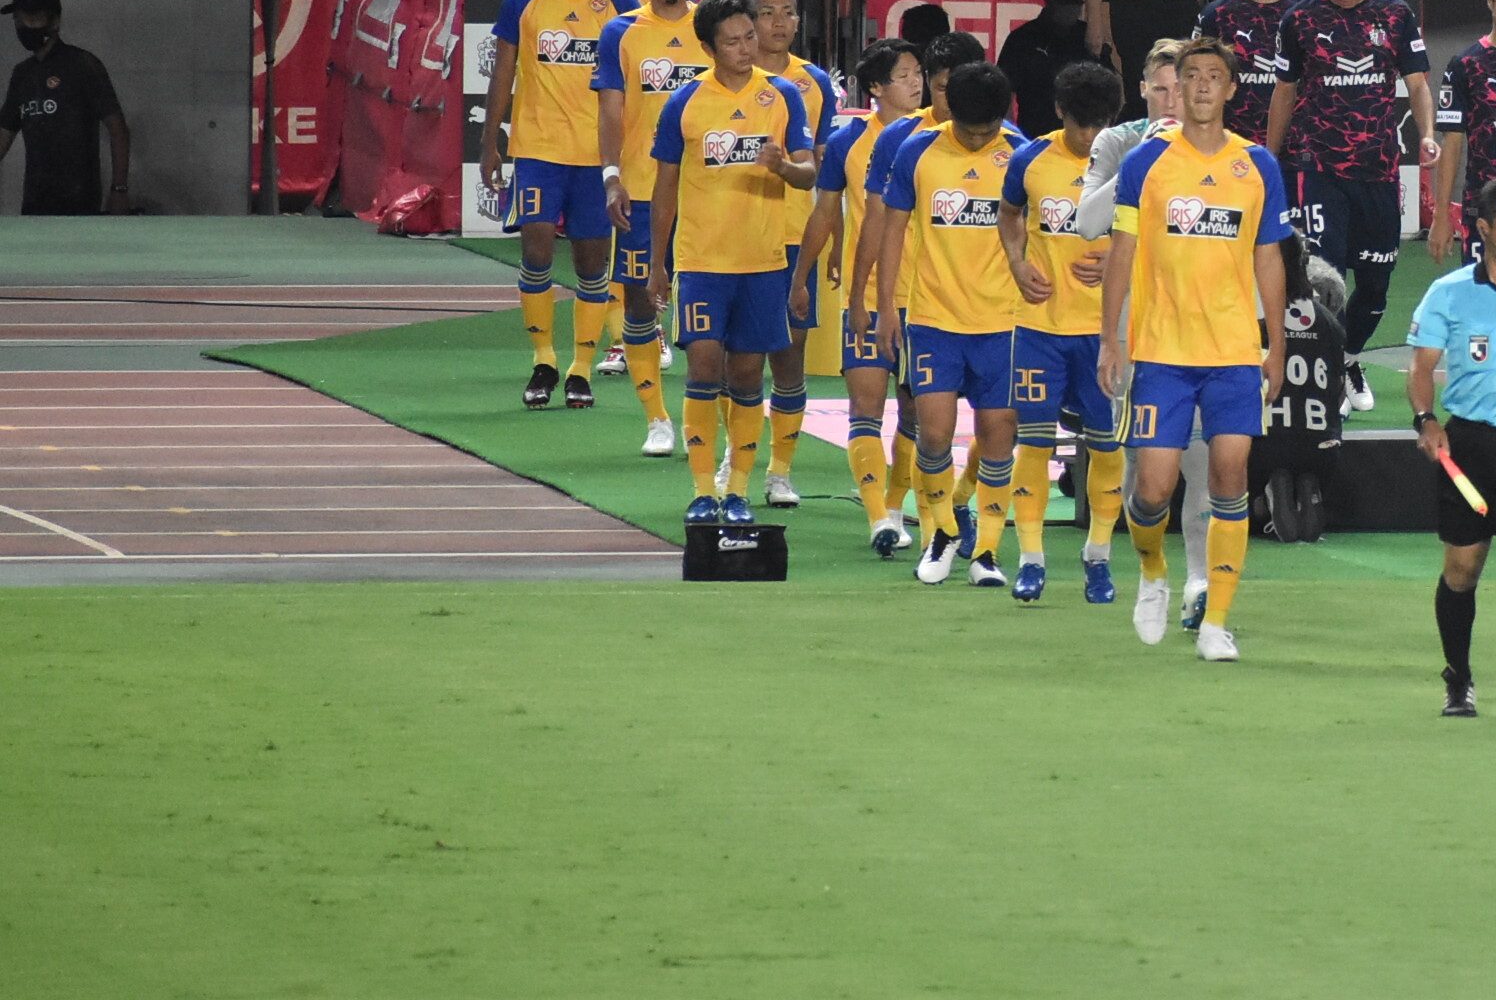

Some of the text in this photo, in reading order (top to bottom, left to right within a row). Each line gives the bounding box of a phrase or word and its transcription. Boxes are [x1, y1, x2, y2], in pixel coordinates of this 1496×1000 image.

[574, 41, 591, 51] IRIS
[562, 50, 598, 62] OHYAM
[679, 67, 695, 77] IRIS
[743, 138, 760, 149] IRIS
[730, 150, 759, 162] OHYA
[519, 188, 541, 215] 13
[972, 201, 991, 212] IRIS
[1209, 211, 1229, 223] IRIS
[1305, 205, 1324, 233] 15
[1195, 222, 1238, 237] OHYAMA
[621, 249, 649, 278] 36
[685, 302, 710, 332] 16
[917, 354, 932, 386] 5
[1015, 369, 1046, 401] 26
